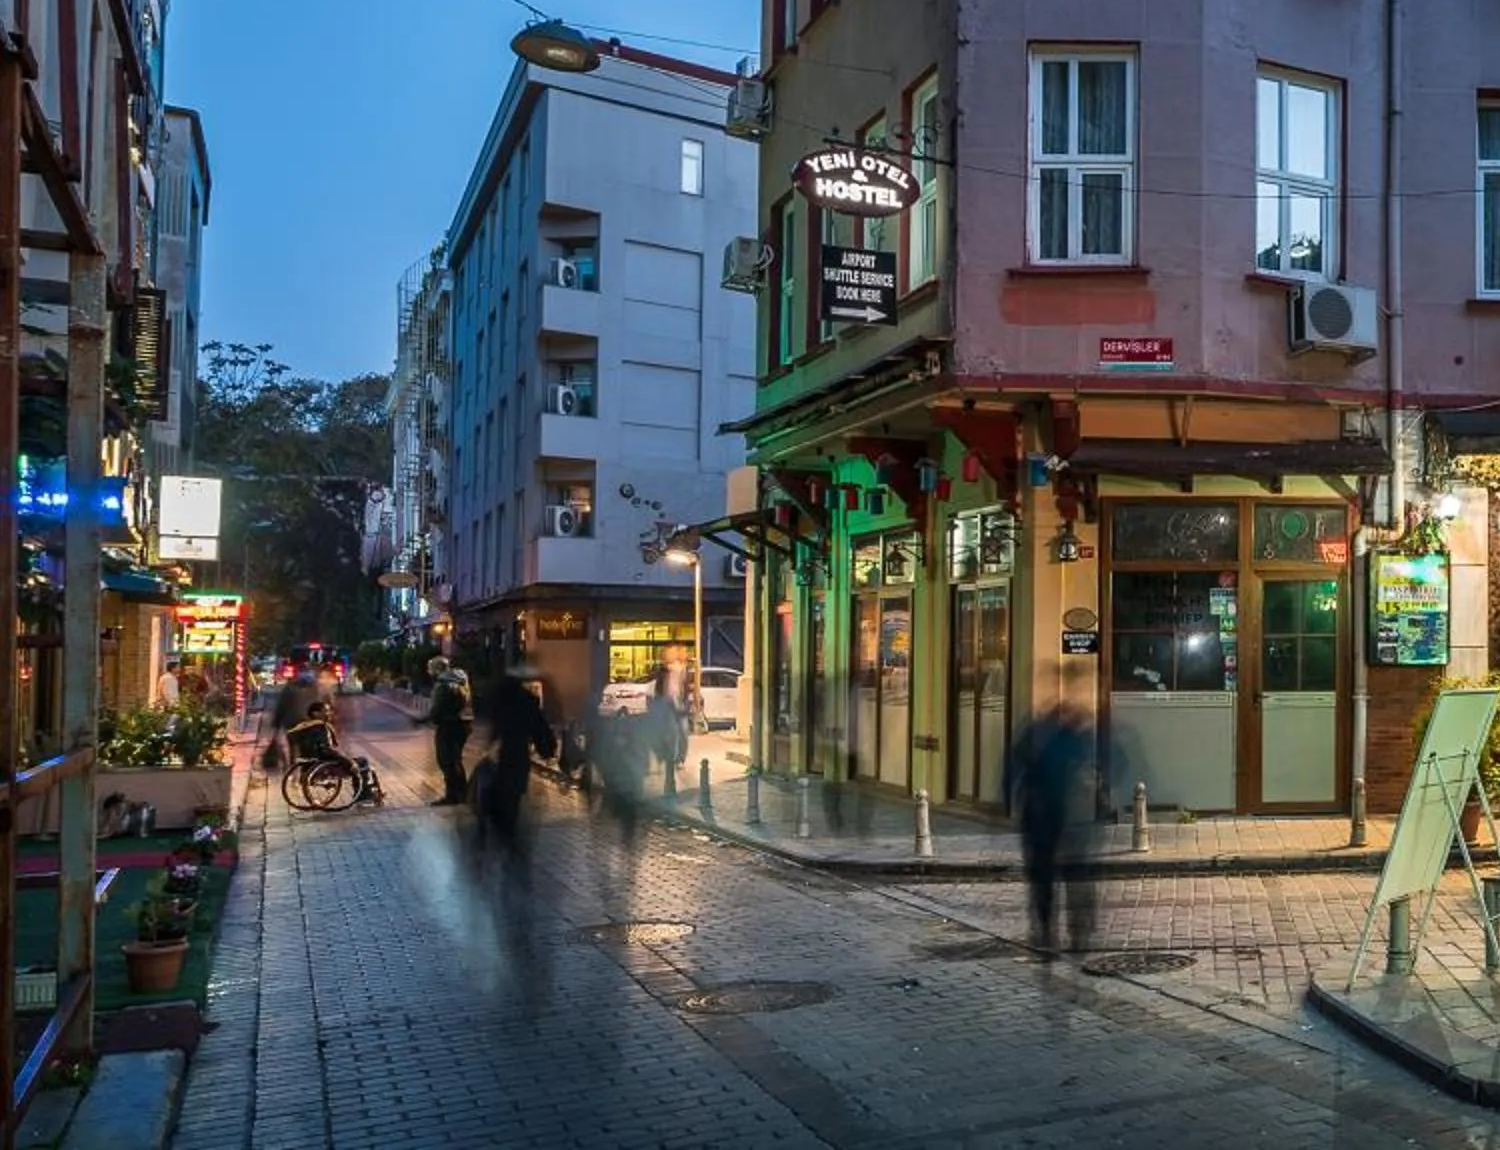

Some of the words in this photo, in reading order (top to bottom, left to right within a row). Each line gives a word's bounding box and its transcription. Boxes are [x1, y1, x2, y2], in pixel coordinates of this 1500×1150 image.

[861, 155, 909, 189] OTEL
[815, 177, 903, 208] HOSTEL
[841, 251, 876, 268] AIRPORT
[823, 267, 859, 284] SHUTTLE
[861, 271, 894, 288] SERVICE
